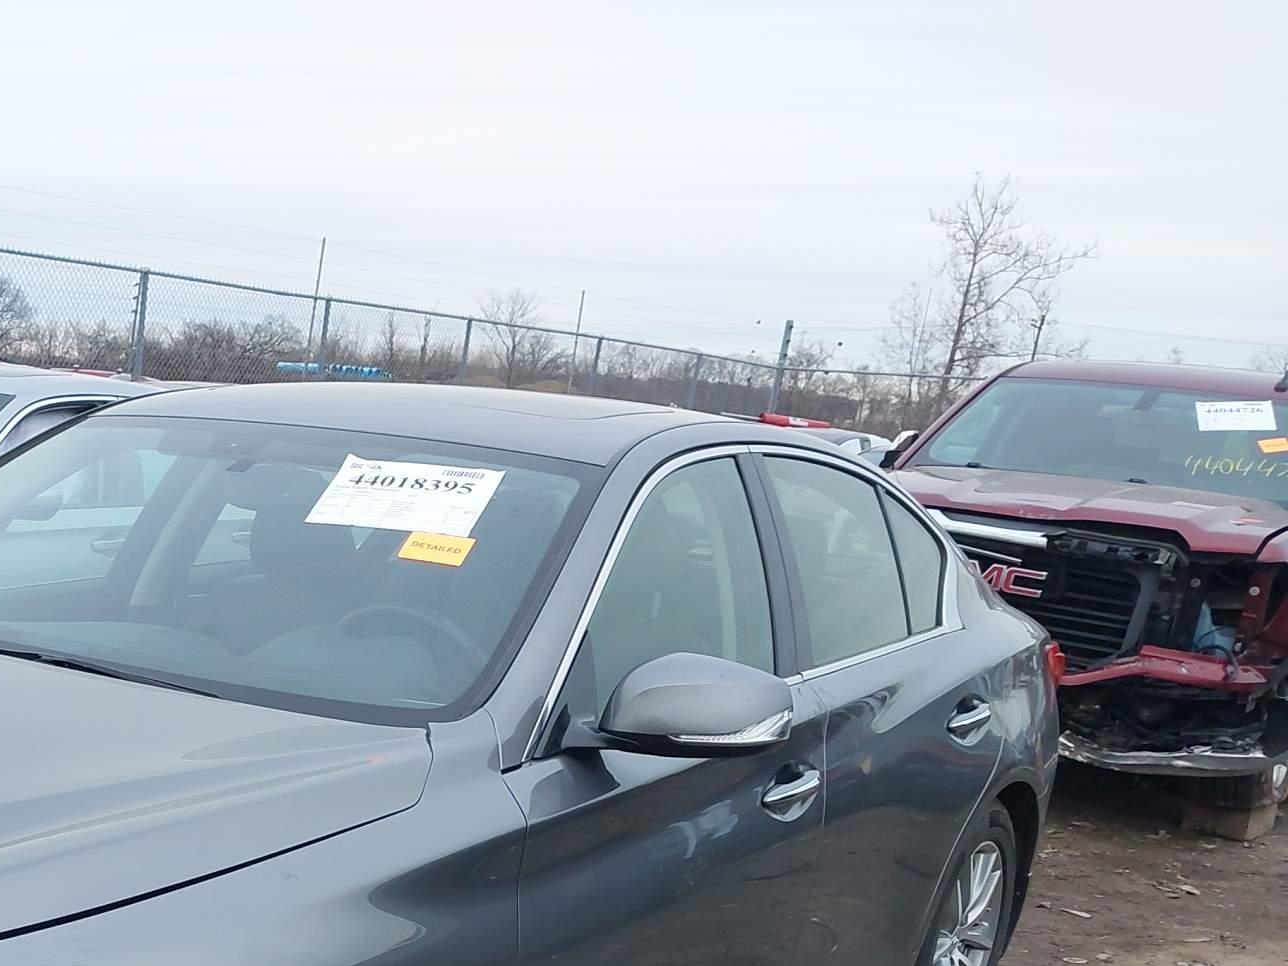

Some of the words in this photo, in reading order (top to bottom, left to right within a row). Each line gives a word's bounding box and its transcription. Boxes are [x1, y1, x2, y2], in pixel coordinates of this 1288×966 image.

[348, 473, 477, 495] 44018395
[410, 540, 463, 555] DETAILED
[967, 559, 1049, 599] MC
